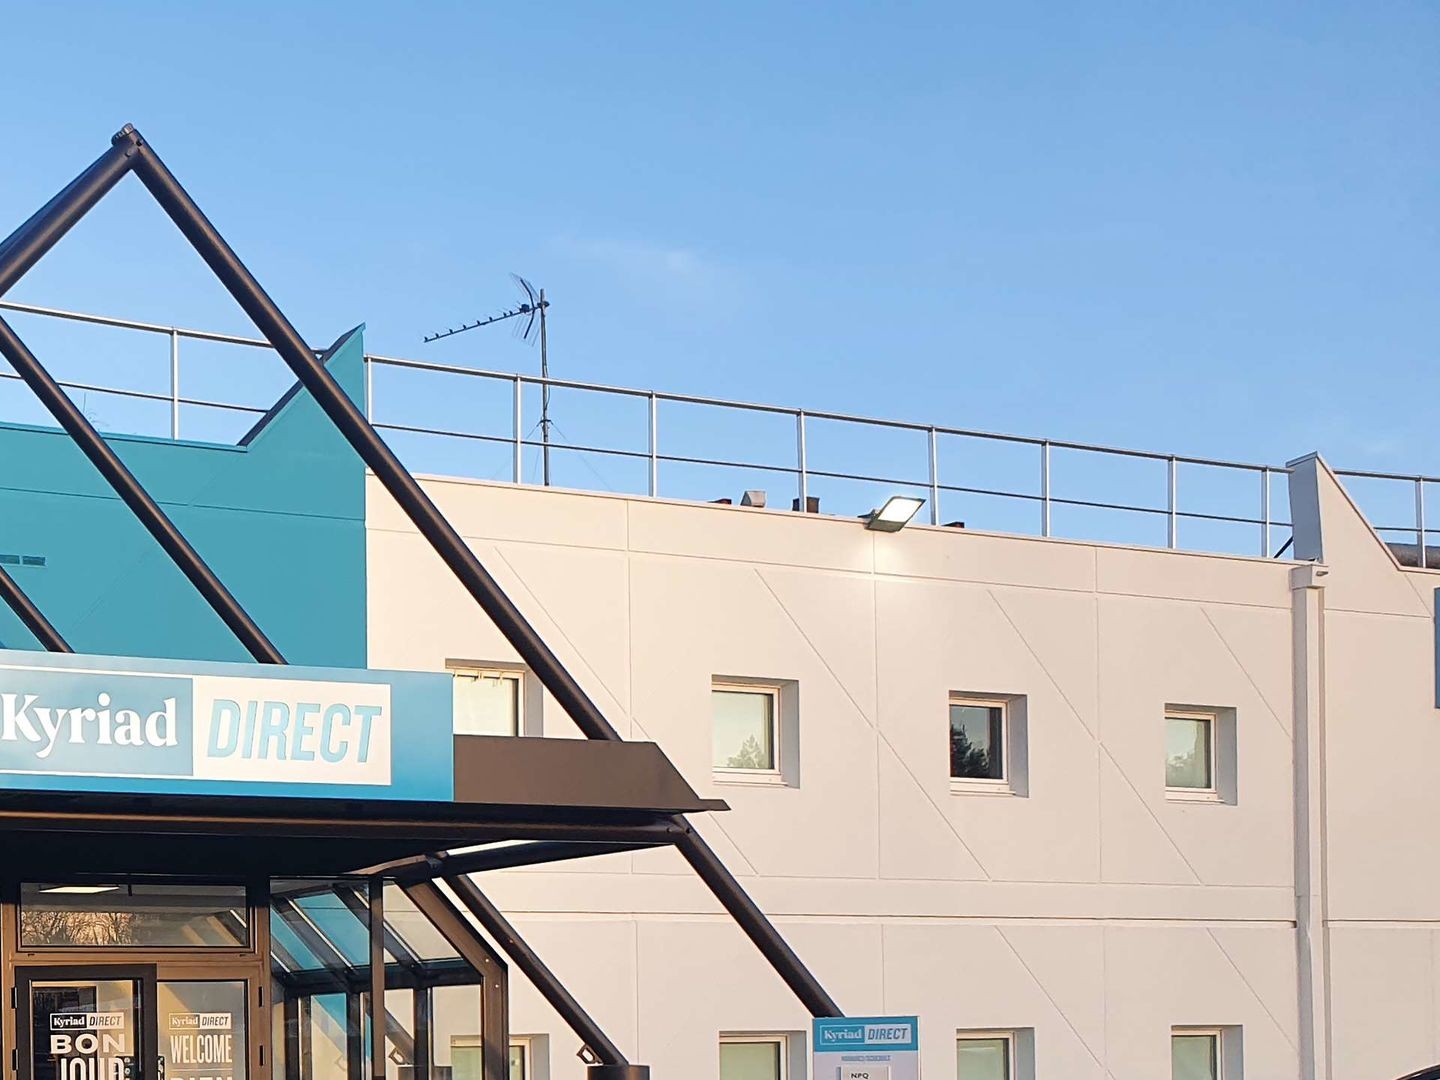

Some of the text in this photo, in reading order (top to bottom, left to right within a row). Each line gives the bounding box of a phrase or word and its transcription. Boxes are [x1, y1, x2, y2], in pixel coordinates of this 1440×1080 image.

[0, 693, 382, 764] Kyriad DIRECT
[53, 1015, 122, 1028] Kyriad DIRECT
[171, 1015, 229, 1028] Kyriad DIRECT
[50, 1033, 125, 1054] BON
[824, 1028, 908, 1042] Kyriad DIRECT
[170, 1034, 232, 1064] WELCOME
